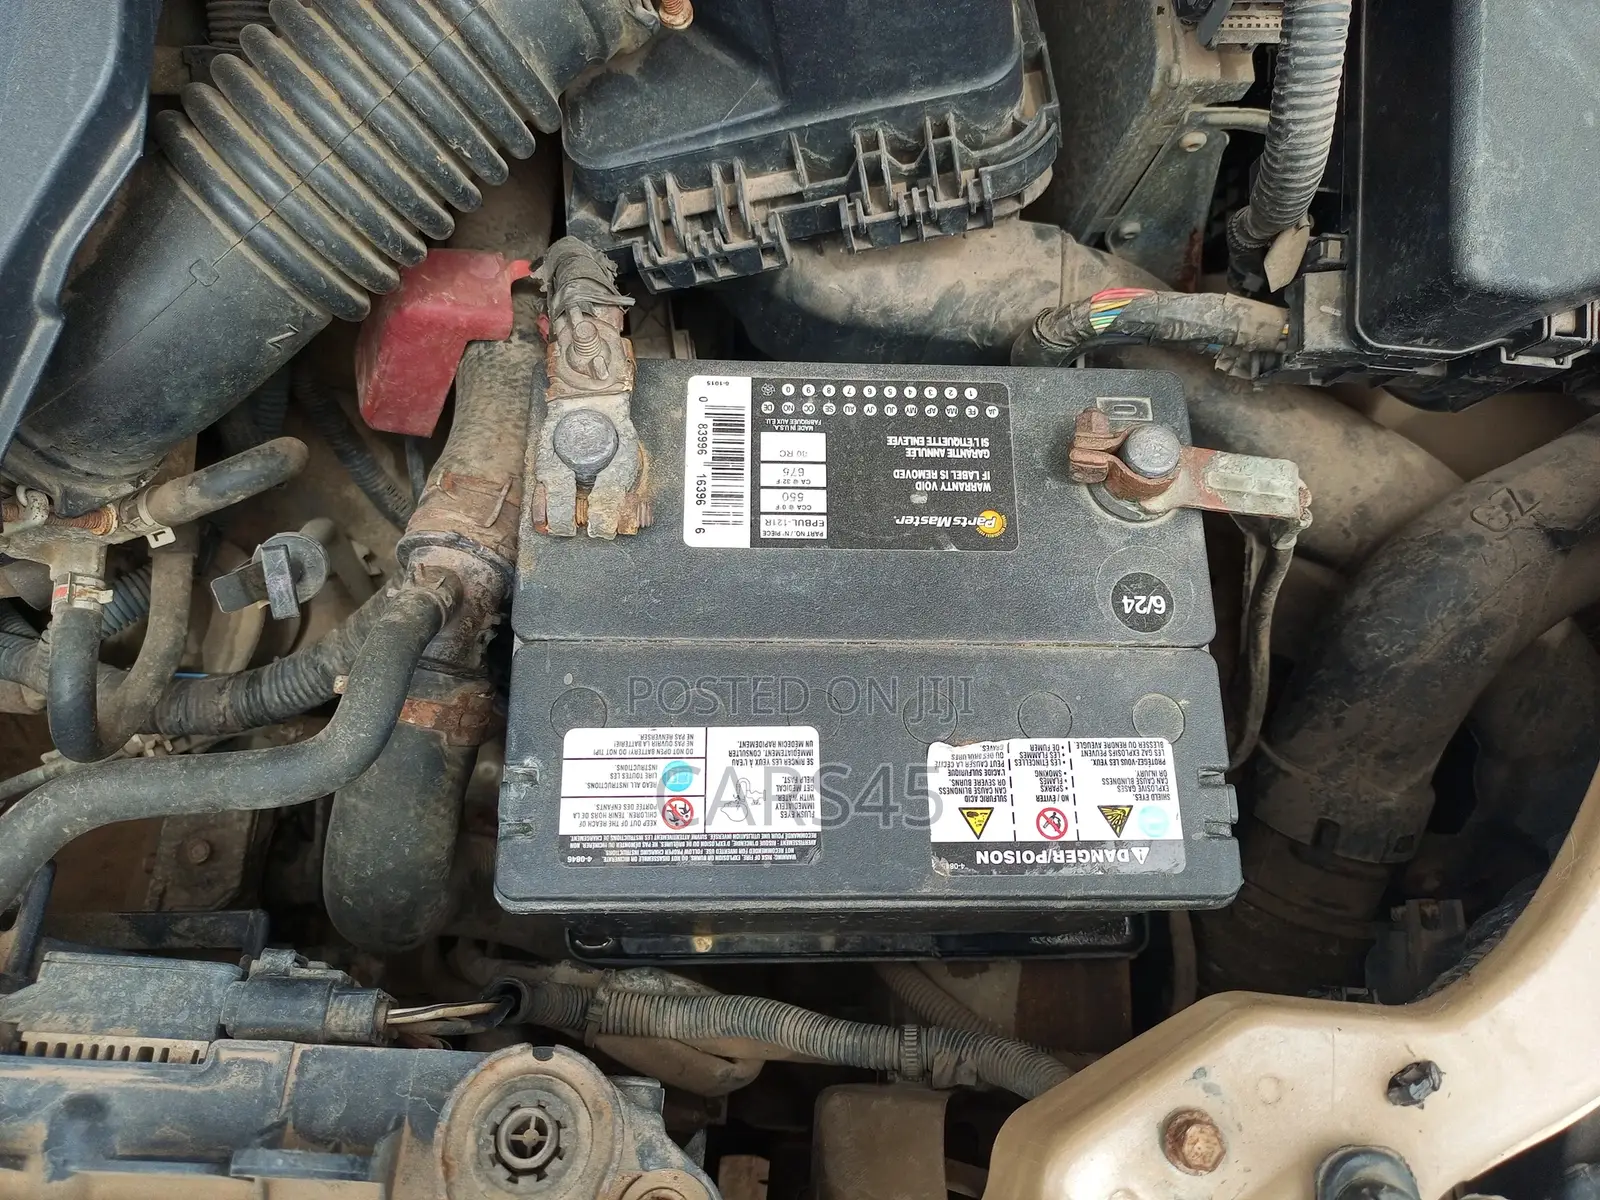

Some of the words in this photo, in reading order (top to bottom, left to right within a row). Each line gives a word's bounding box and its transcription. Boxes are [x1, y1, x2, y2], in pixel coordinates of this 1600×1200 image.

[697, 423, 708, 456] 83996
[887, 436, 924, 447] ENLEVÉE
[926, 437, 979, 448] L'ÉTIQUETTE
[981, 438, 989, 447] SI
[906, 448, 945, 459] ANNULÉE
[947, 448, 990, 458] GARANTIE
[783, 468, 804, 476] 675
[893, 469, 937, 479] REMOVED
[940, 470, 948, 479] IS
[951, 470, 979, 480] LABEL
[982, 471, 990, 480] IF
[695, 474, 706, 506] 16396
[916, 481, 938, 490] VOID
[940, 482, 991, 492] WARRANTY
[782, 492, 804, 502] 550
[1122, 596, 1166, 614] 6/24
[778, 741, 804, 749] MÉDECIN
[750, 759, 753, 768] À
[1036, 795, 1056, 804] ÉVITER
[976, 849, 1129, 864] DANGER/POISON
